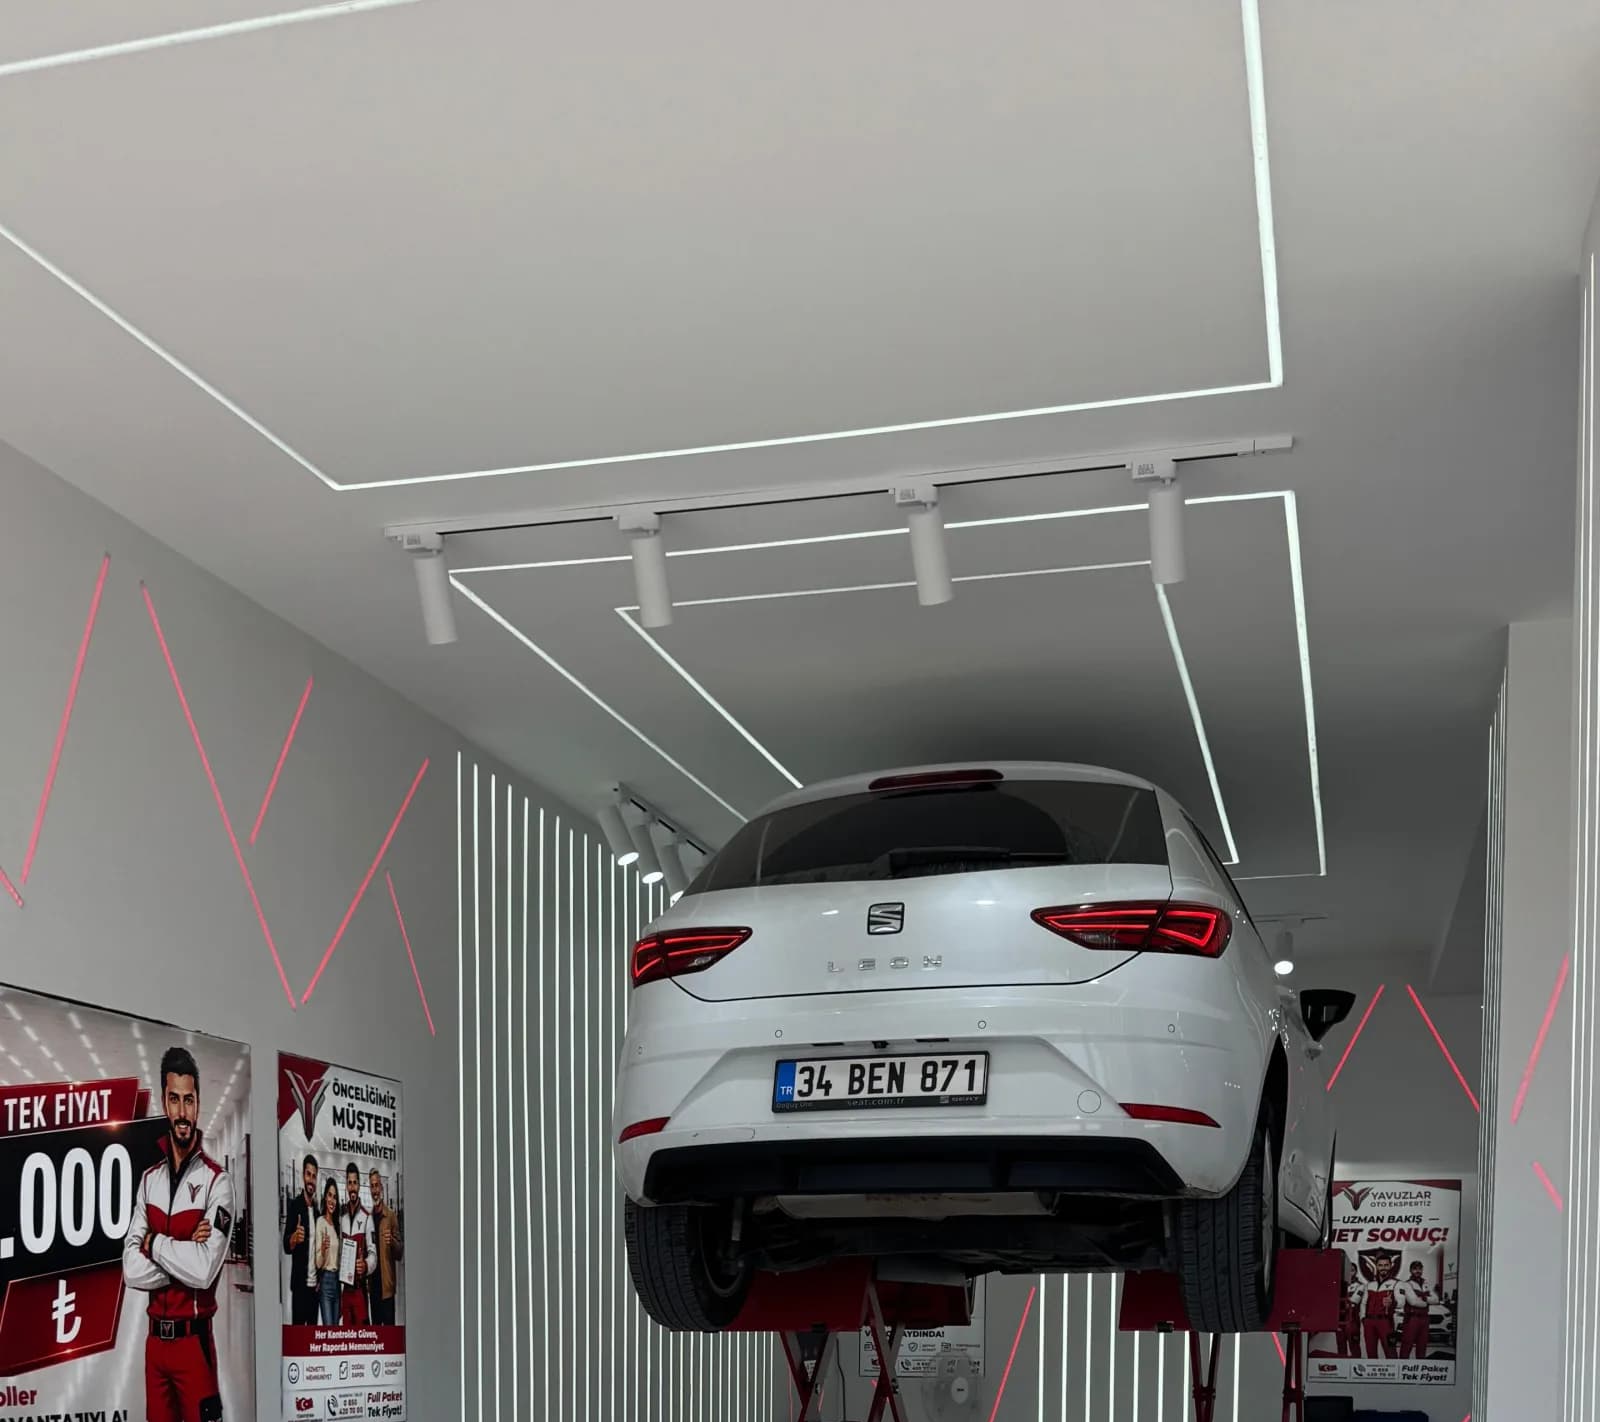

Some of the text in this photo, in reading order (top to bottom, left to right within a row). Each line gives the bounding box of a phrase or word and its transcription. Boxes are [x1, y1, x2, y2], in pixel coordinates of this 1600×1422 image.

[827, 955, 943, 973] LEON
[780, 1059, 976, 1098] TR 34 BEN 871
[332, 1078, 396, 1110] ÖNCELİĞİMİZ
[4, 1085, 112, 1132] TEK FİYAT
[332, 1103, 396, 1139] MÜŞTERİ
[333, 1137, 396, 1161] MEMNUNİYETİ
[1371, 1191, 1431, 1201] YAVUZLAR
[1342, 1215, 1423, 1225] UZMAN BAKIŞ
[1367, 1227, 1449, 1246] SONUÇ!
[315, 1328, 378, 1340] Her Kontrolde Güven,
[309, 1340, 385, 1354] Her Raporda Memnuniyet
[1402, 1364, 1449, 1373] Full Paket
[1402, 1373, 1447, 1382] Tek Fiyat!
[367, 1392, 381, 1403] Full
[382, 1390, 402, 1402] Paket
[367, 1406, 381, 1418] Tek
[381, 1404, 402, 1418] Fiyat!
